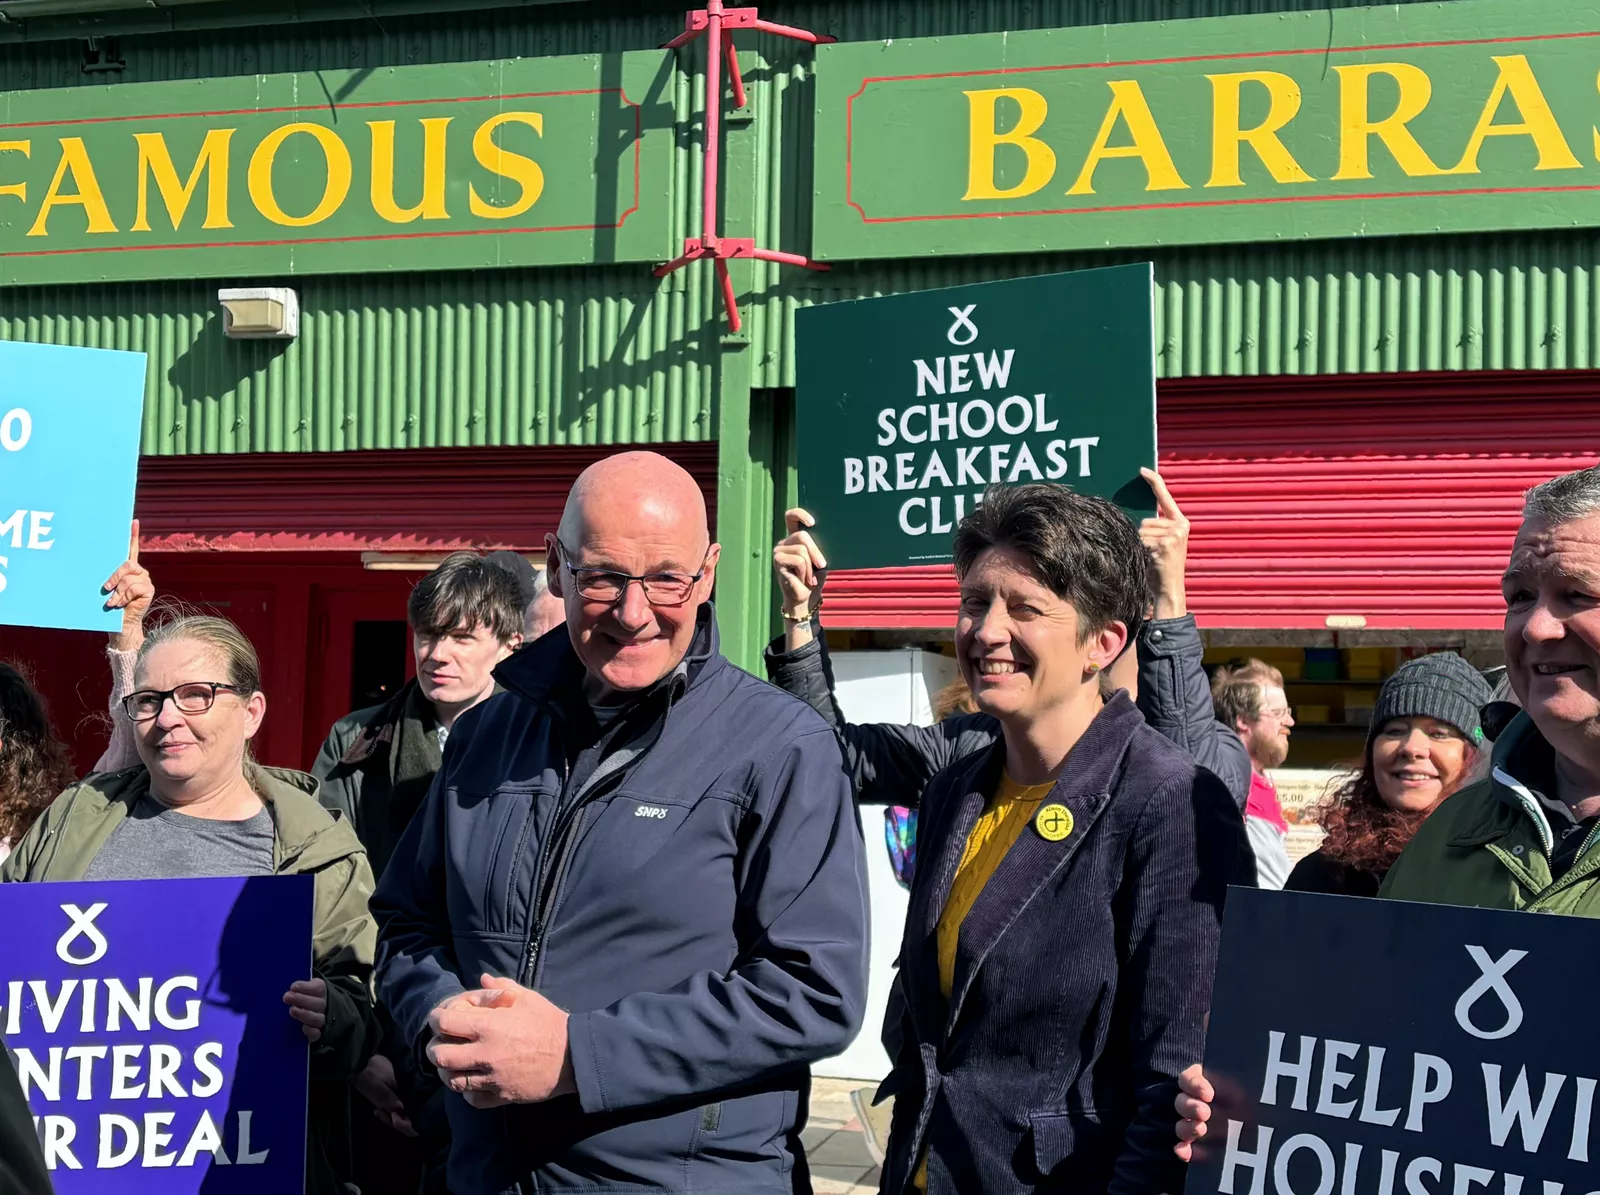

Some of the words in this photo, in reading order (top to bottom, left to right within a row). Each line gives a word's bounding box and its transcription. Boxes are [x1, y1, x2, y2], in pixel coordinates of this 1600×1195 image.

[963, 54, 1600, 201] BARRA
[912, 348, 1016, 397] NEW
[877, 393, 1060, 446] SCHOOL
[844, 436, 1100, 495] BREAKFAST
[634, 806, 660, 818] SNP
[0, 976, 202, 1035] IVING
[13, 1042, 224, 1101] NTERS
[1258, 1030, 1453, 1133] HELP
[1480, 1062, 1598, 1163] WI
[96, 1108, 270, 1169] DEAL
